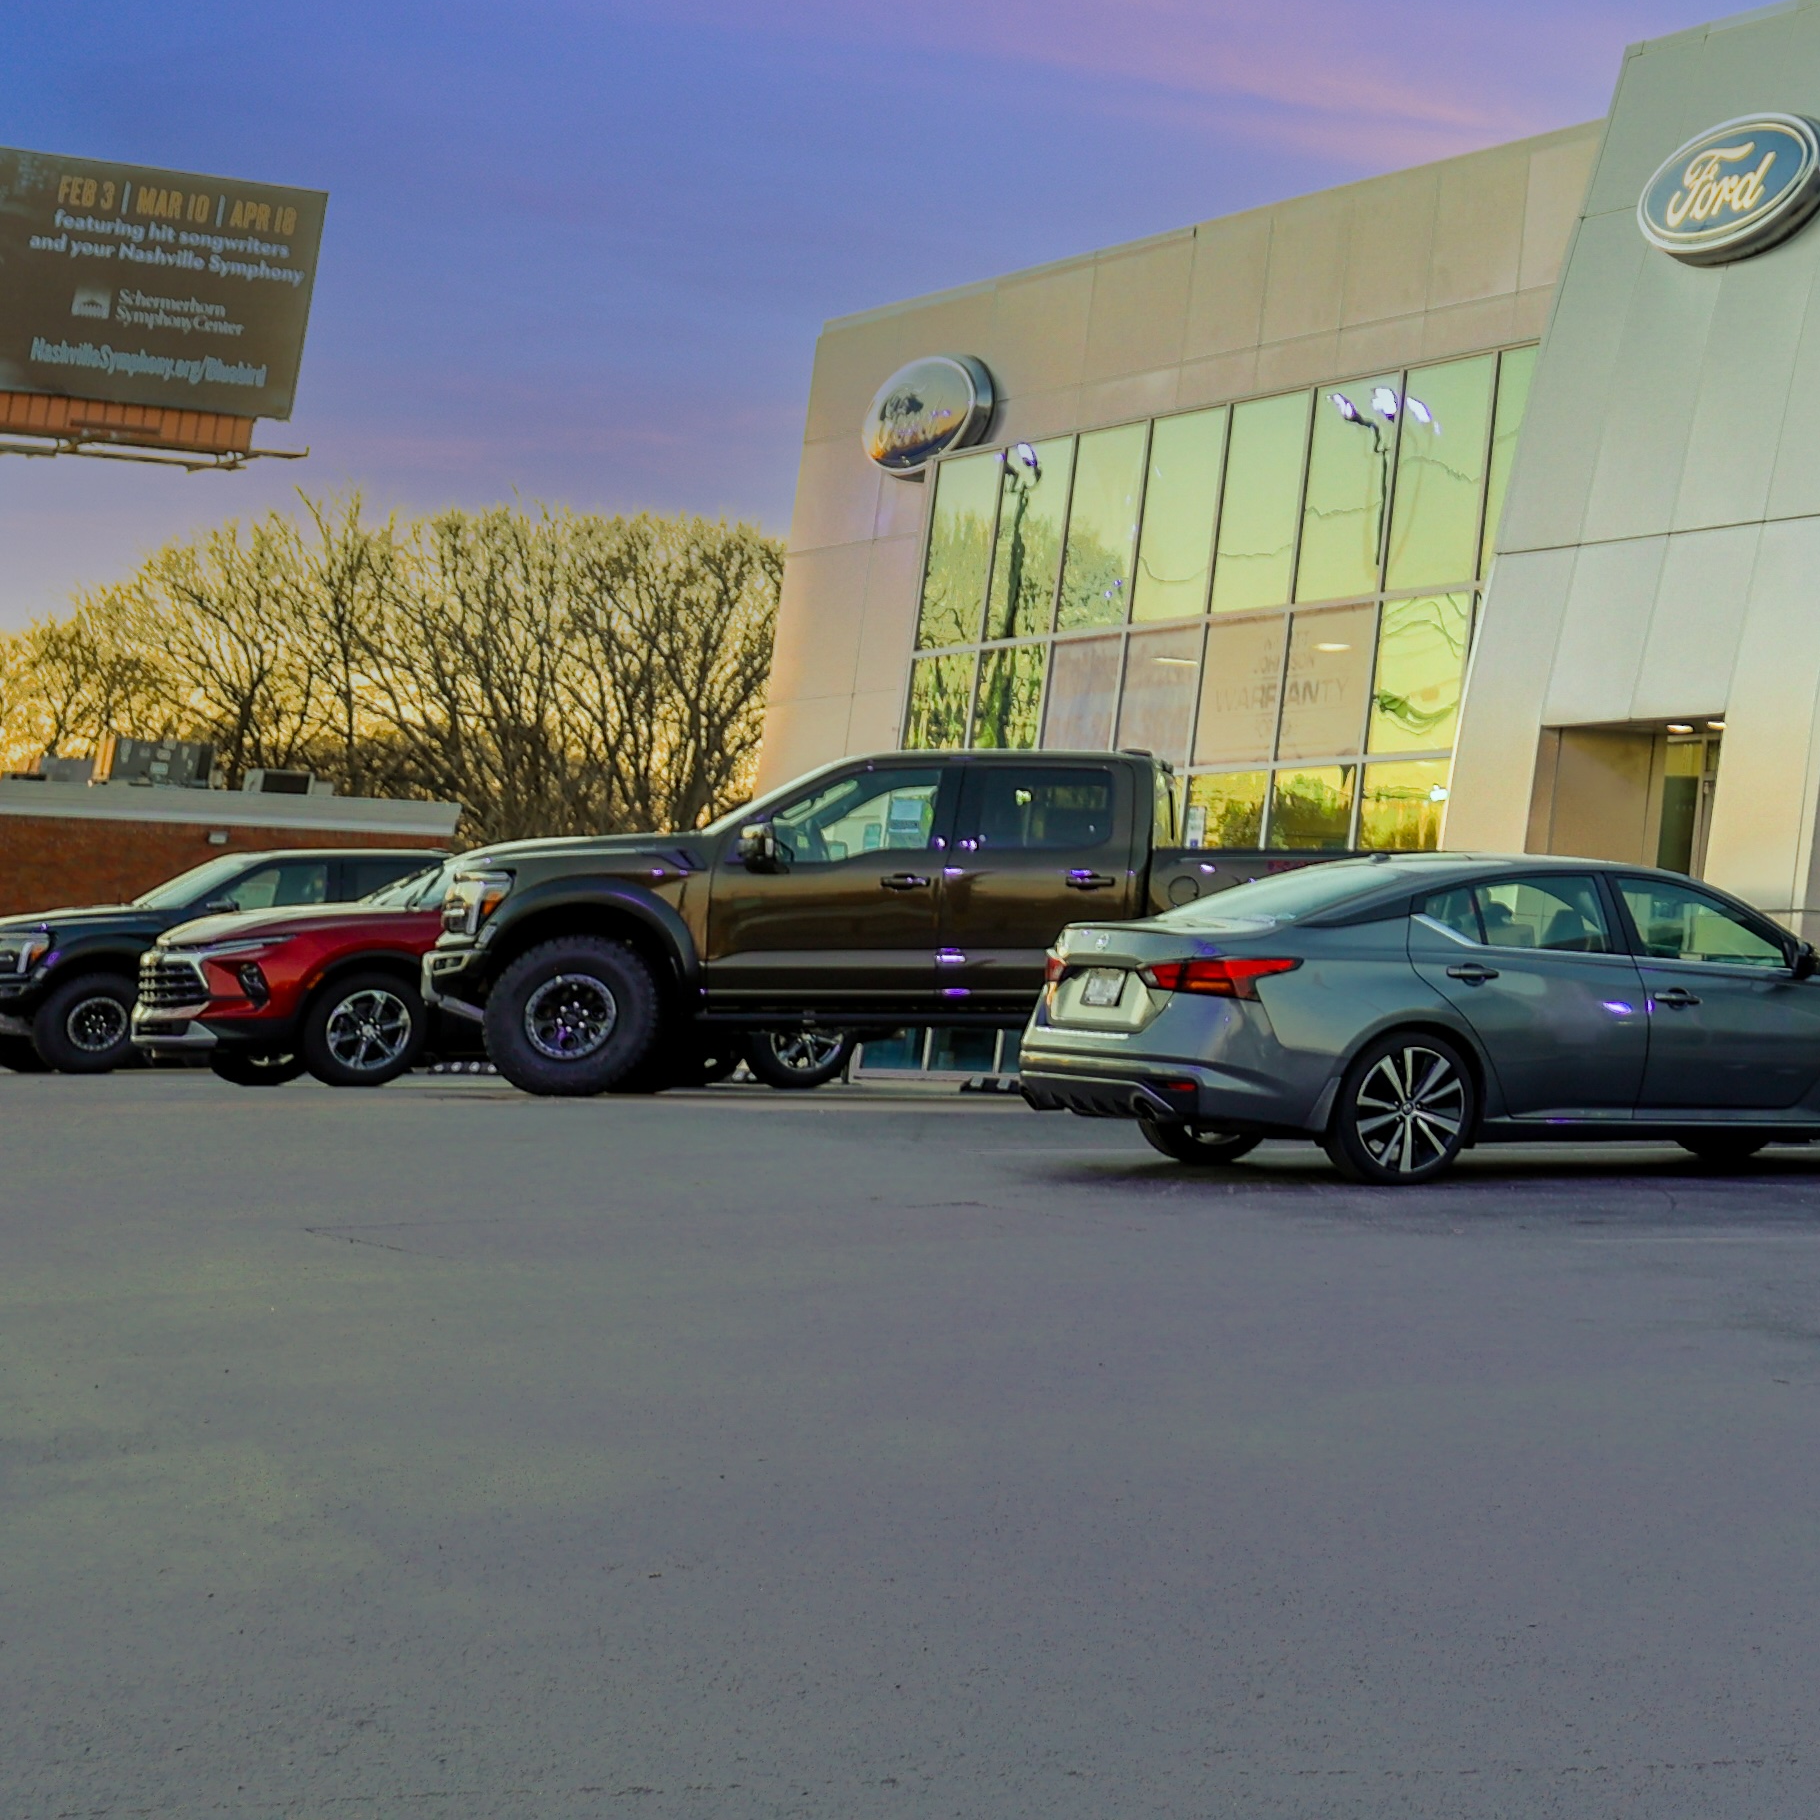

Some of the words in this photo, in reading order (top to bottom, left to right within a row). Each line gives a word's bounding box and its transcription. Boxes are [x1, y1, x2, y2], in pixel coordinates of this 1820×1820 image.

[58, 175, 98, 208] FEB
[100, 181, 115, 210] 3
[136, 186, 183, 220] MAR
[187, 193, 210, 224] 10
[229, 199, 271, 232] APR
[274, 206, 298, 236] 18
[1666, 141, 1776, 228] Ford
[54, 208, 145, 243] featuring
[148, 221, 177, 243] hit
[178, 230, 290, 258] songwriters
[29, 233, 68, 253] and
[70, 240, 116, 258] your
[118, 242, 206, 271] Nashville
[208, 253, 305, 288] Symphony
[115, 305, 192, 334] Symphony
[193, 314, 245, 336] Center
[118, 288, 226, 318] Schermerhorn
